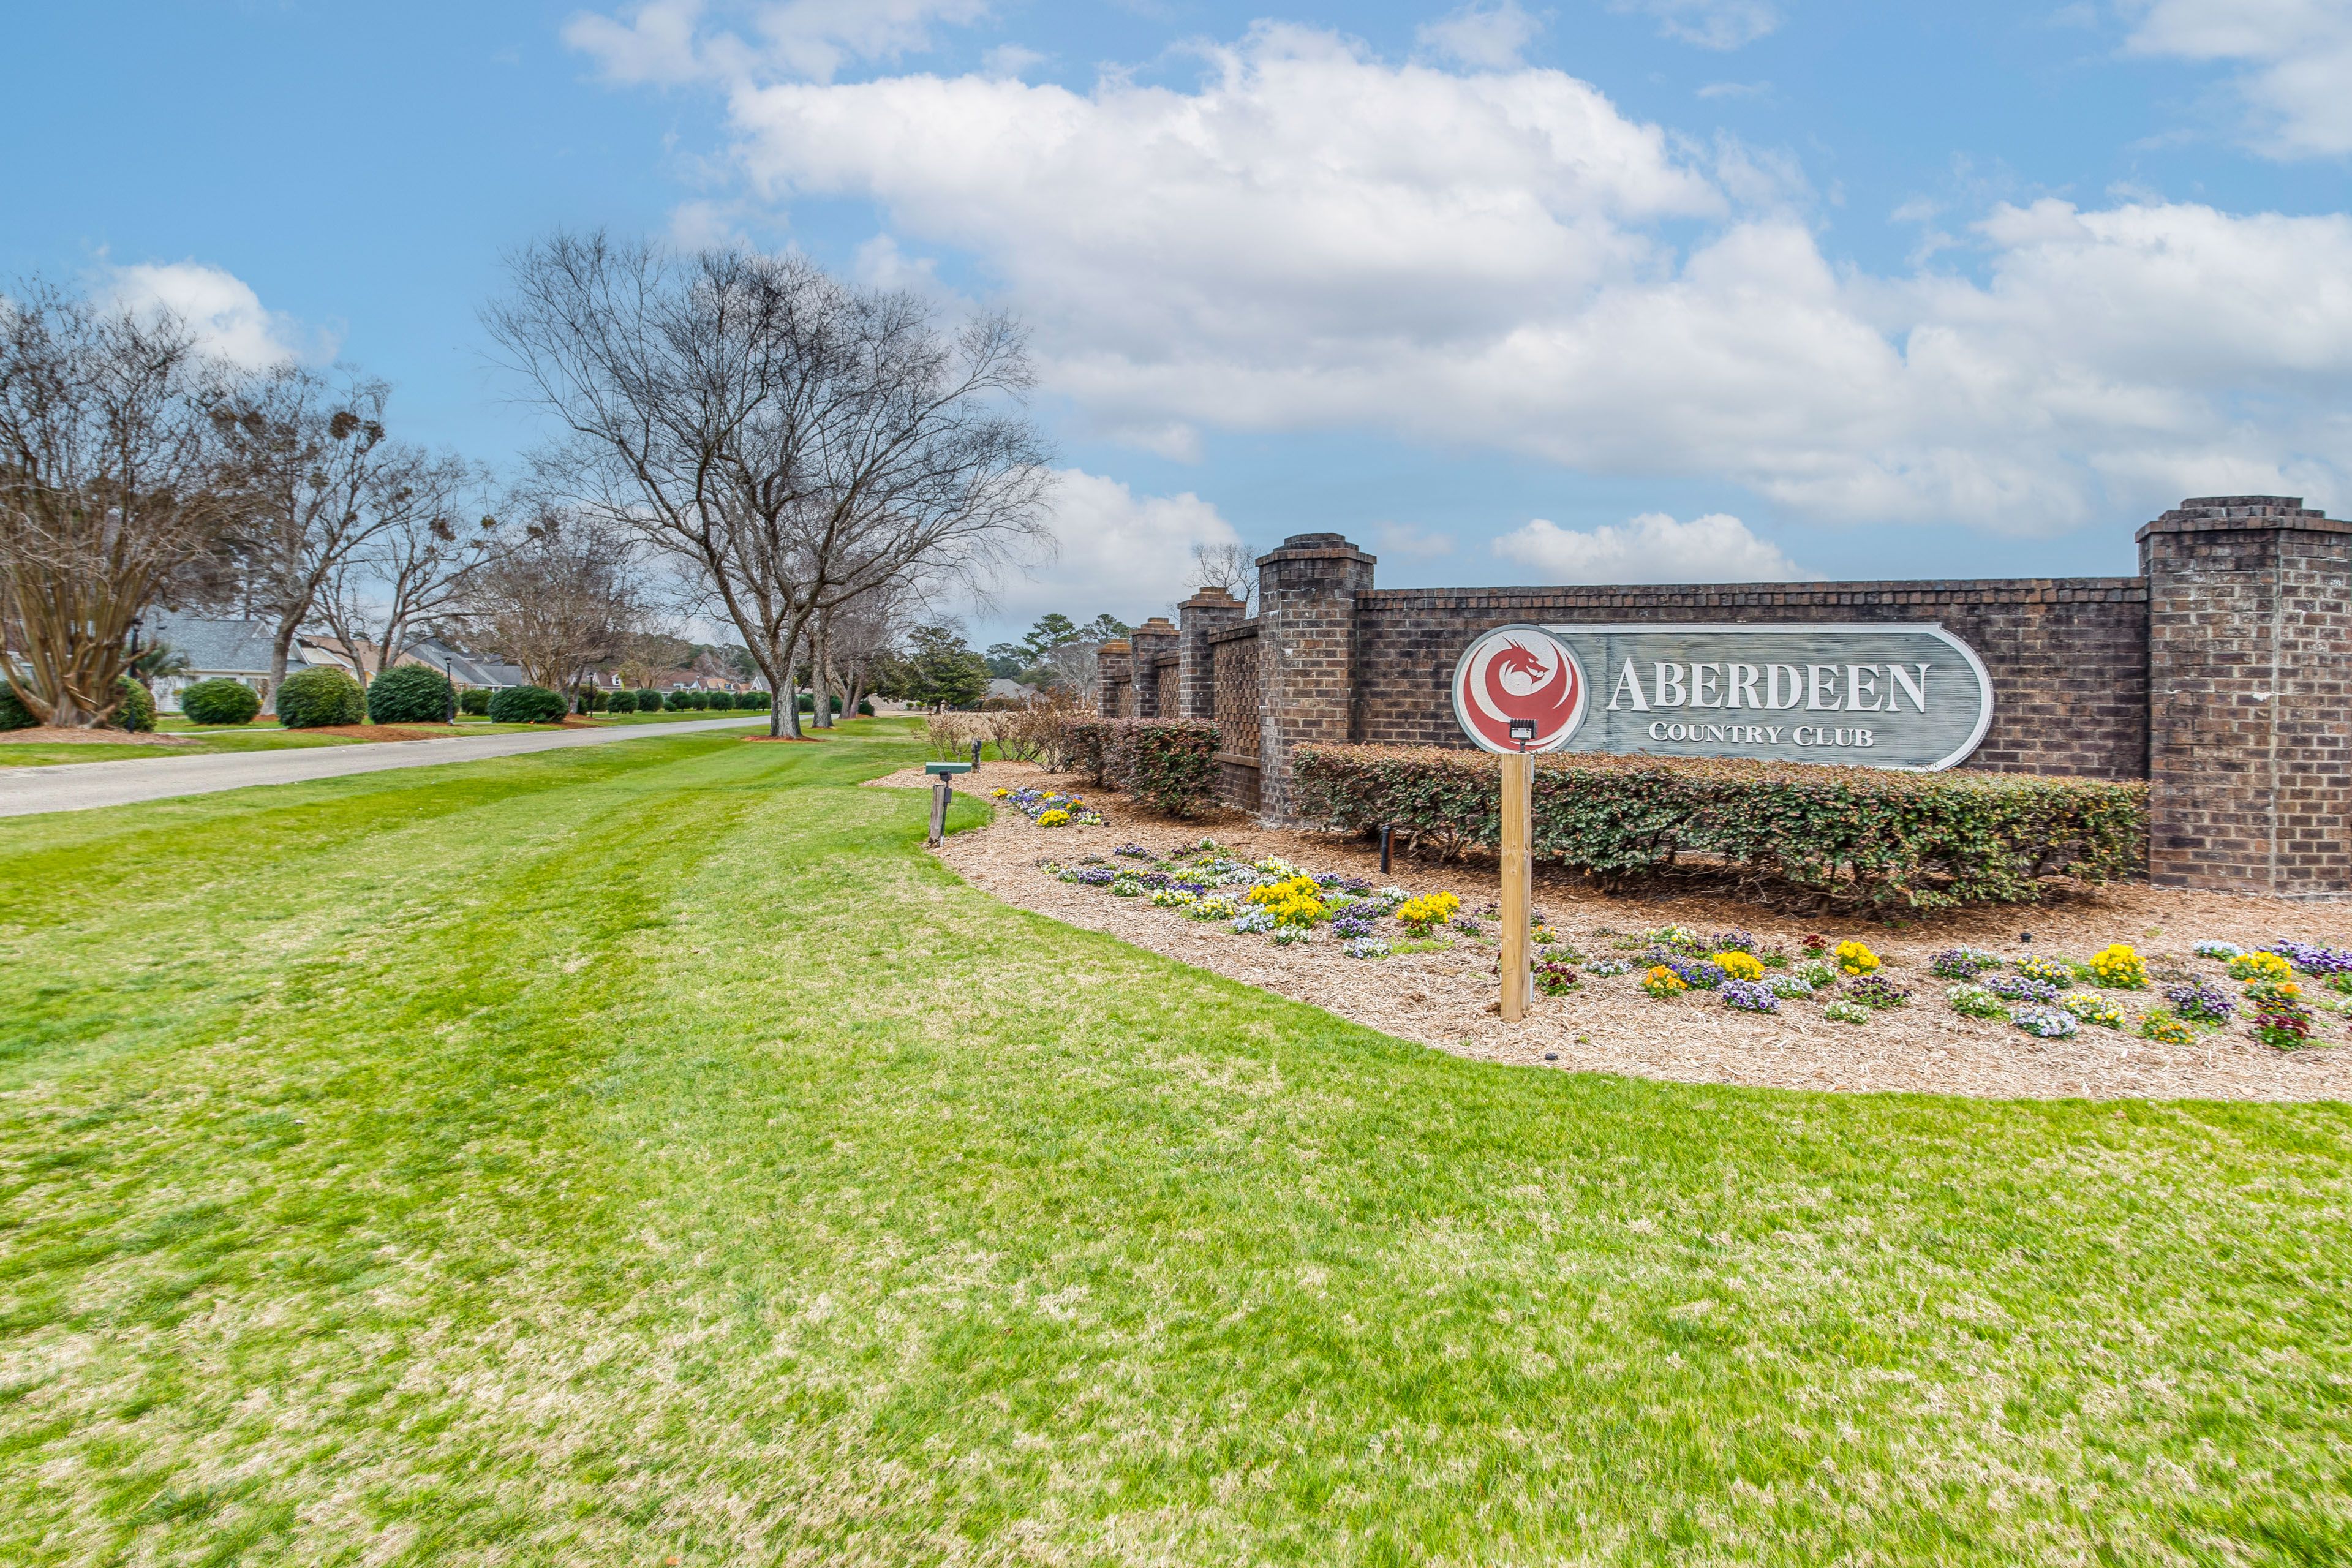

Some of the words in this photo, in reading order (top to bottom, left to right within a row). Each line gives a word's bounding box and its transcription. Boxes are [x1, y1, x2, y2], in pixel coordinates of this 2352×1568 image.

[1606, 657, 1931, 713] ABERDEEN
[1649, 722, 1784, 744] COUNTRY
[1792, 726, 1874, 748] CLUB
